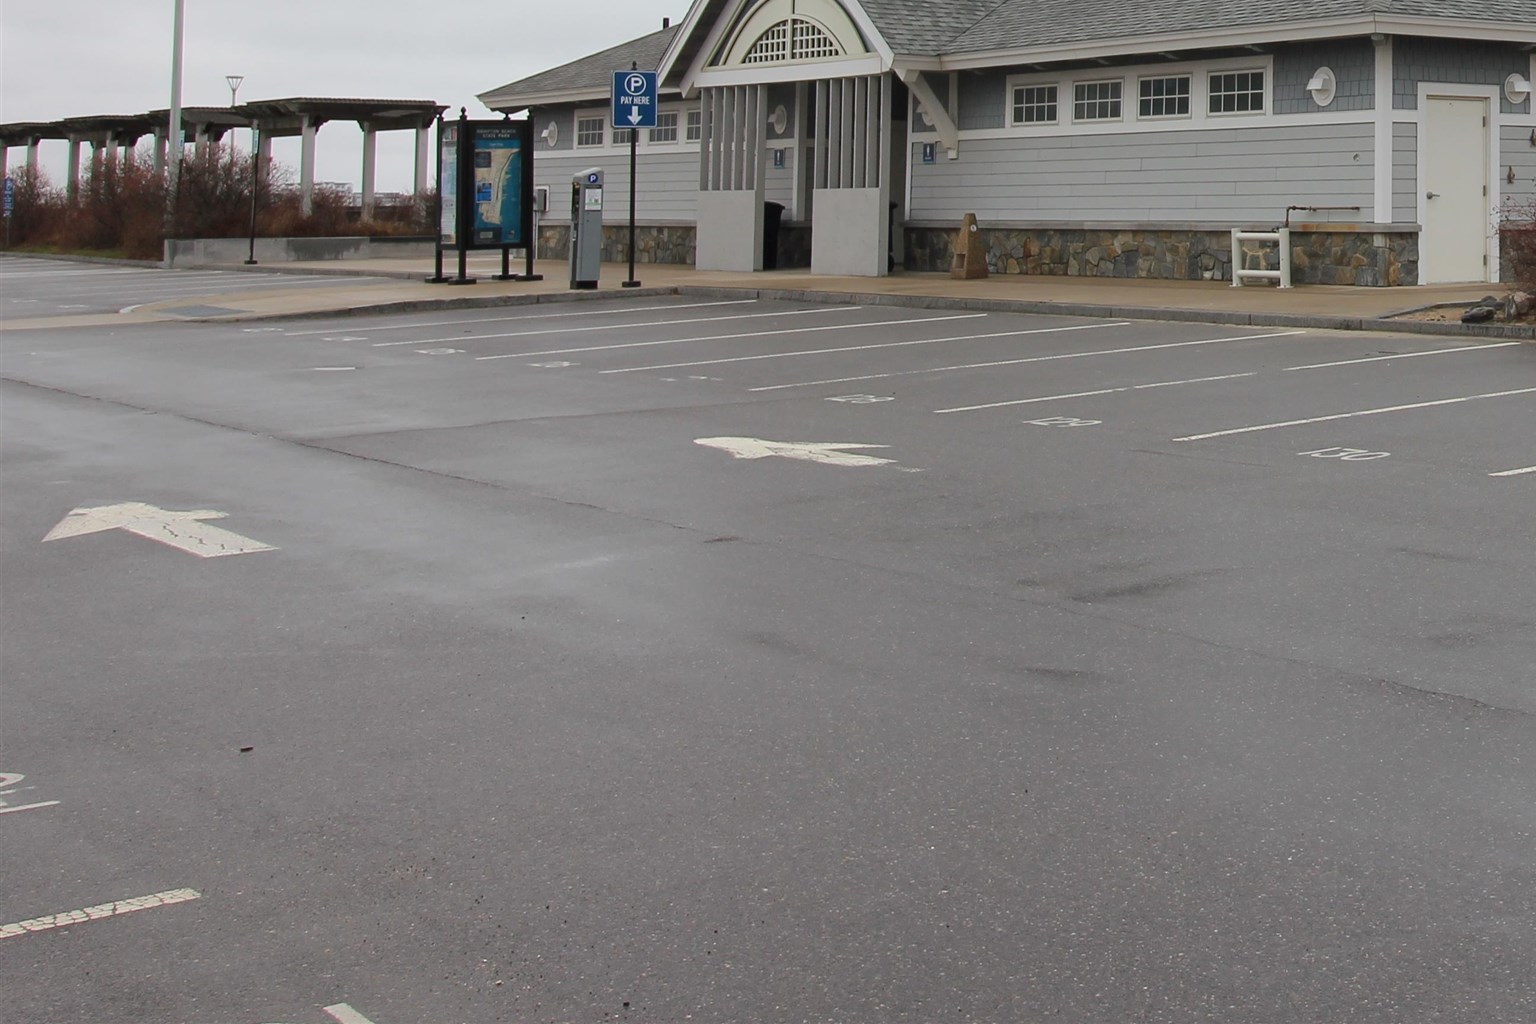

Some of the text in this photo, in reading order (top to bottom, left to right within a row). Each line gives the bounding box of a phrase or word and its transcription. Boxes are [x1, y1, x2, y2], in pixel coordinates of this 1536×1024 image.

[630, 77, 643, 92] P
[620, 95, 650, 105] PAY HERE
[1296, 447, 1391, 461] 130
